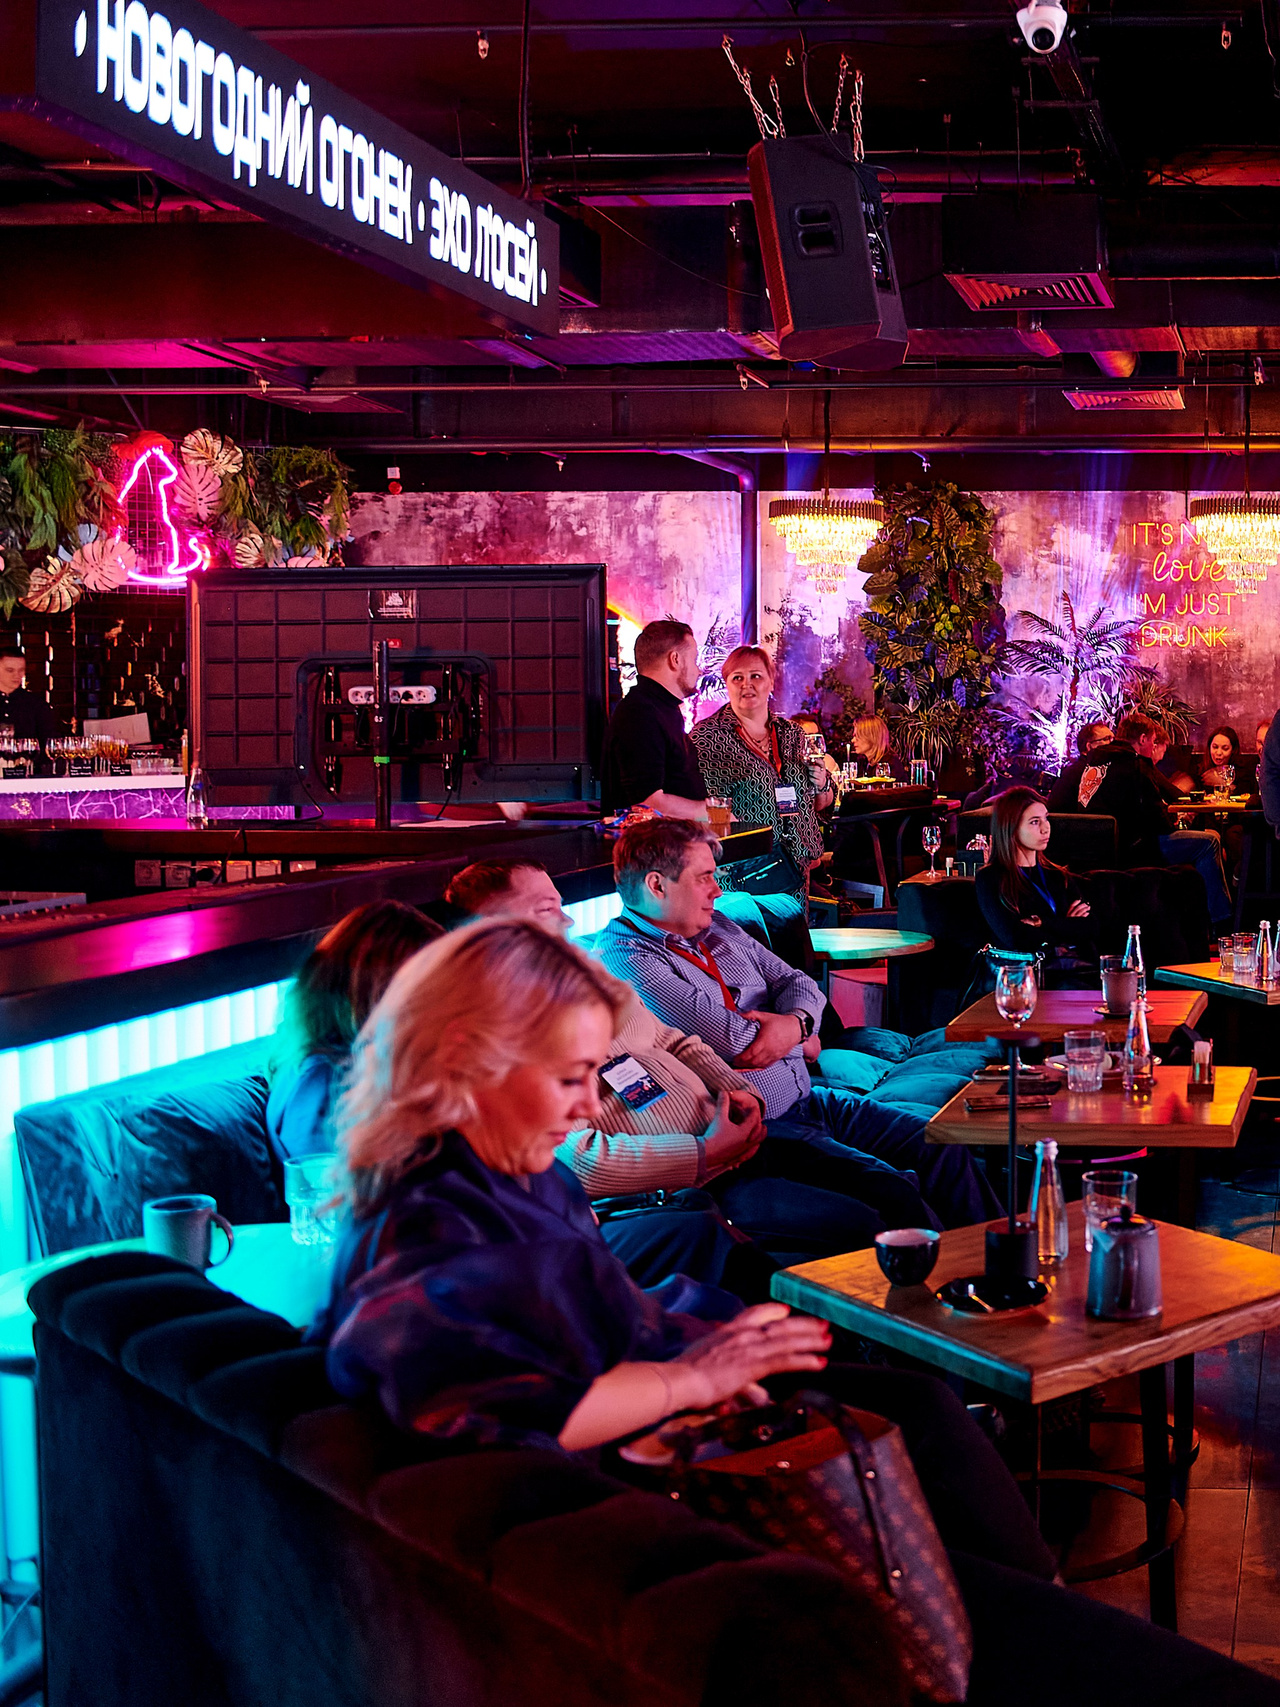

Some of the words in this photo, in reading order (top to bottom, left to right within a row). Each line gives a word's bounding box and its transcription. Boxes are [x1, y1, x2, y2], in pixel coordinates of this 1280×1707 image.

[97, 0, 314, 195] НОВОГОДНИЙ
[319, 113, 413, 245] ОГОНЕК
[429, 177, 473, 275] ЭХО
[1133, 522, 1174, 545] IT'S
[1152, 551, 1227, 582] love
[1133, 592, 1166, 615] I'M
[1175, 593, 1237, 615] JUST
[1141, 625, 1228, 647] DRUNK
